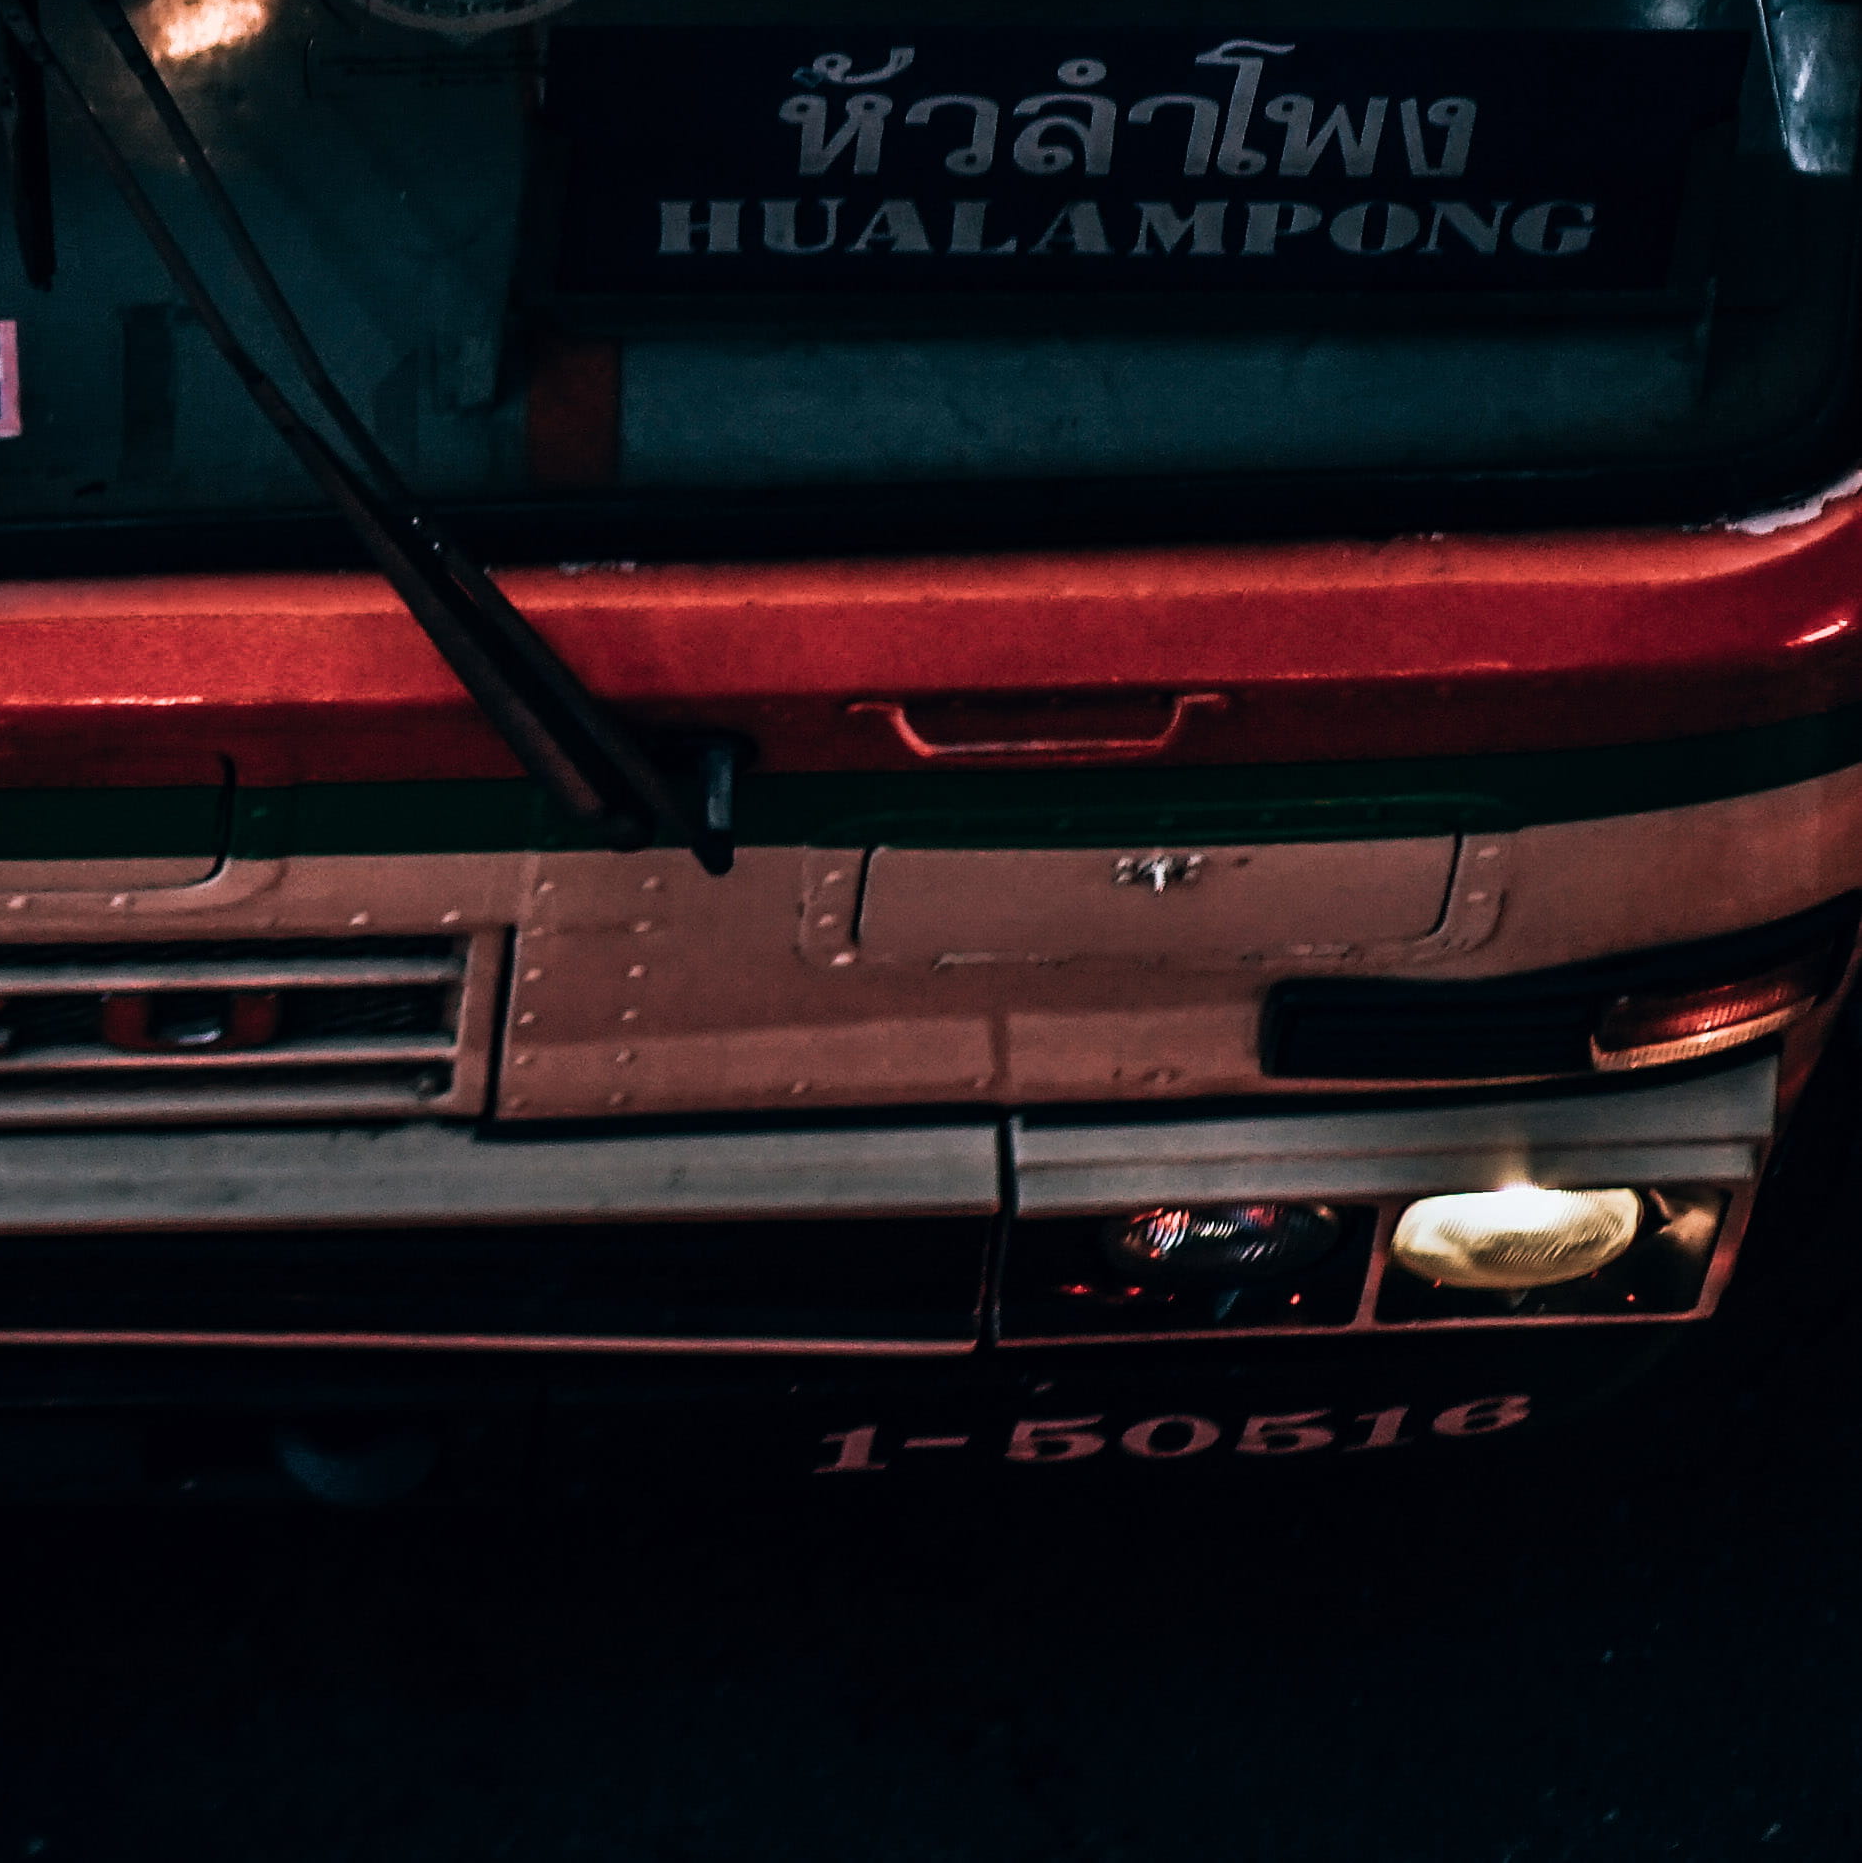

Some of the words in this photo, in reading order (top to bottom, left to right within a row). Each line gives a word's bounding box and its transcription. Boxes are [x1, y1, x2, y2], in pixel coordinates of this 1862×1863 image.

[779, 39, 1476, 177] หัวลำโพง
[657, 200, 1596, 256] HUALAMPONG
[812, 1392, 1533, 1474] 1-50516
